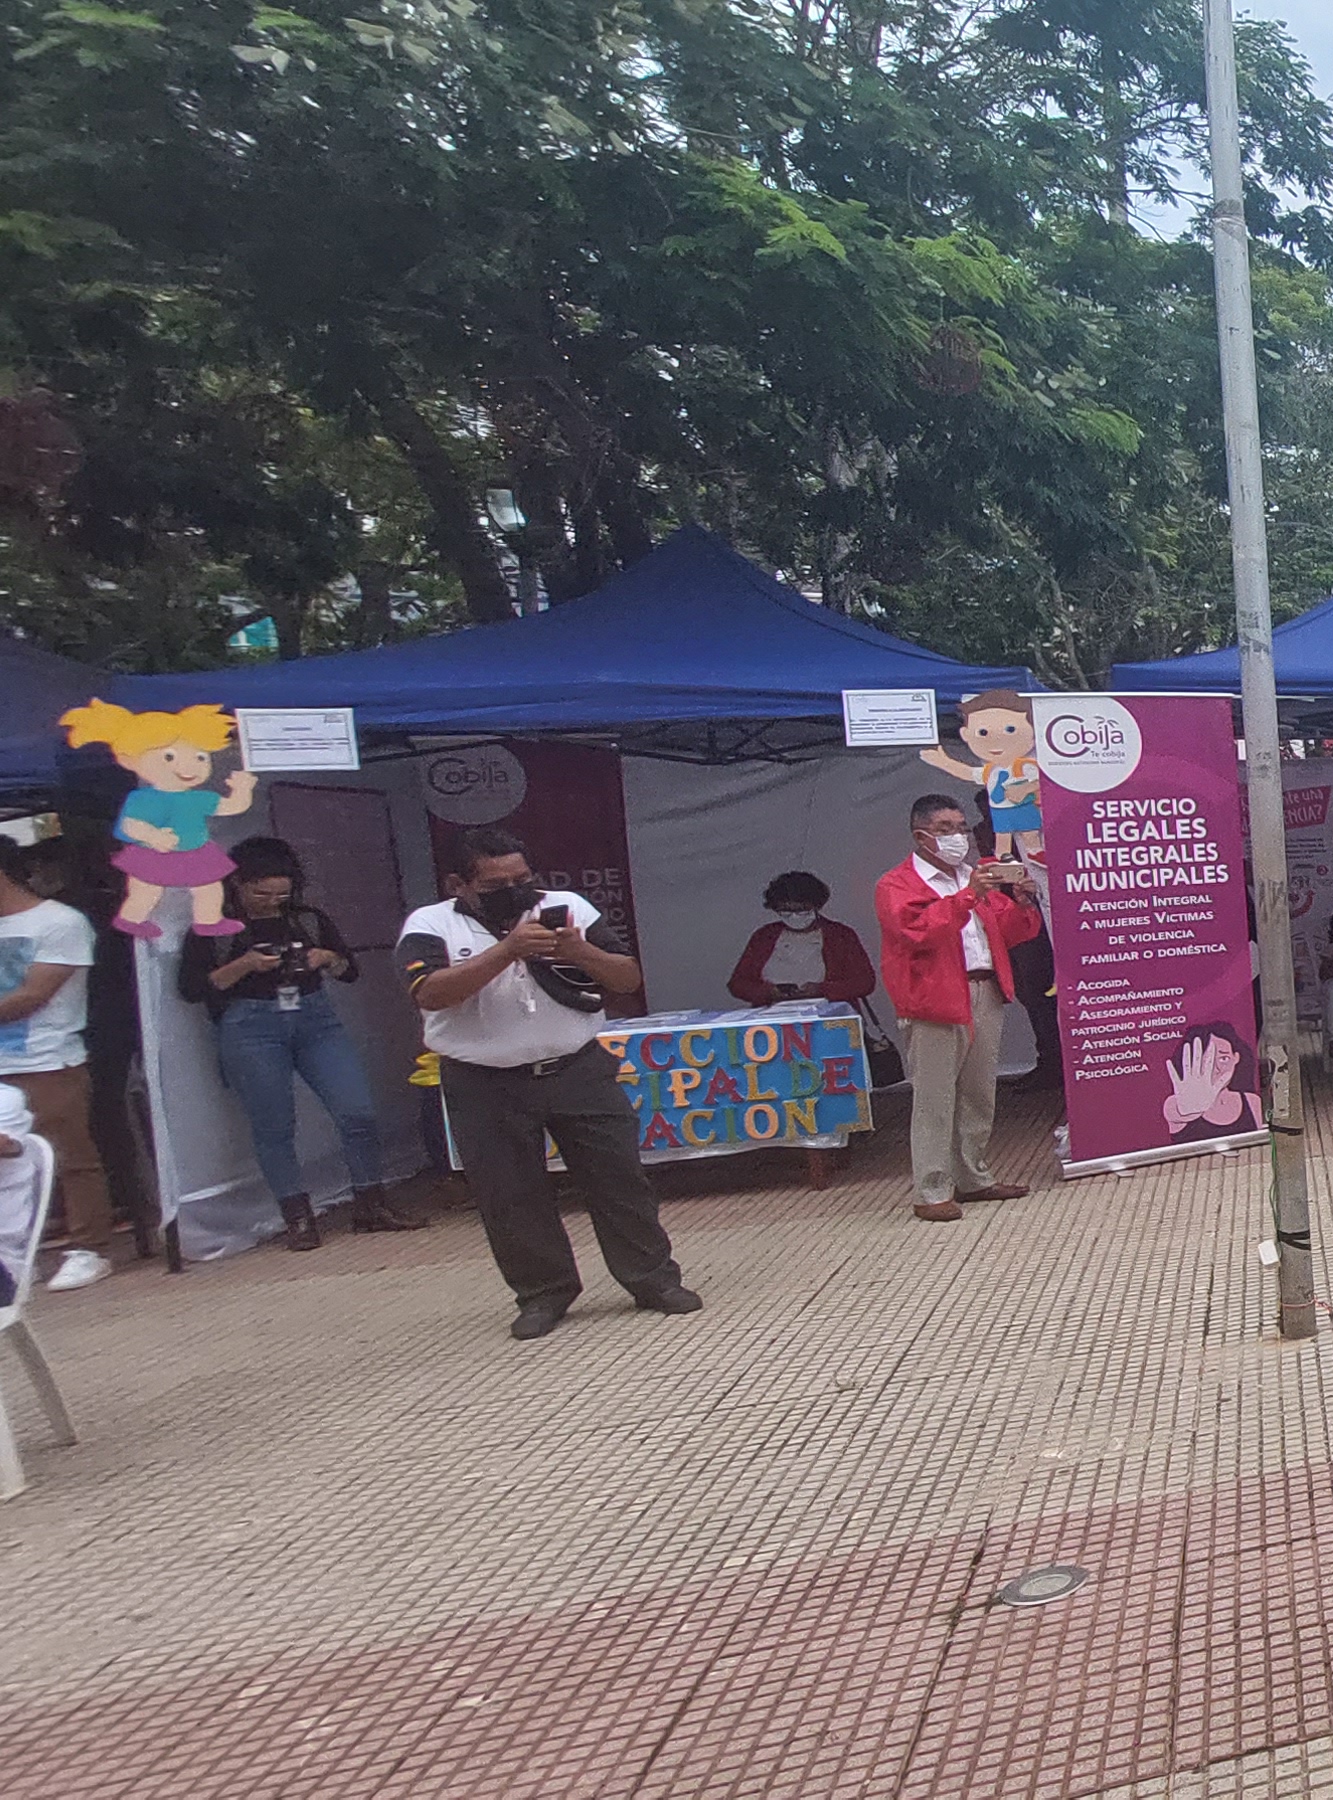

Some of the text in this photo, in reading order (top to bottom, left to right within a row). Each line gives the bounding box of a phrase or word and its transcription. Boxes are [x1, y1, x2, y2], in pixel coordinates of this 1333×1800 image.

[1045, 714, 1124, 758] Cobija
[1092, 798, 1196, 818] SERVICIO
[1086, 818, 1207, 844] LEGALES
[1076, 843, 1219, 869] INTEGRALES
[582, 867, 622, 888] DE
[1065, 865, 1229, 893] MUNICIPALES
[789, 1056, 859, 1098] DE
[642, 1099, 819, 1148] ACION
